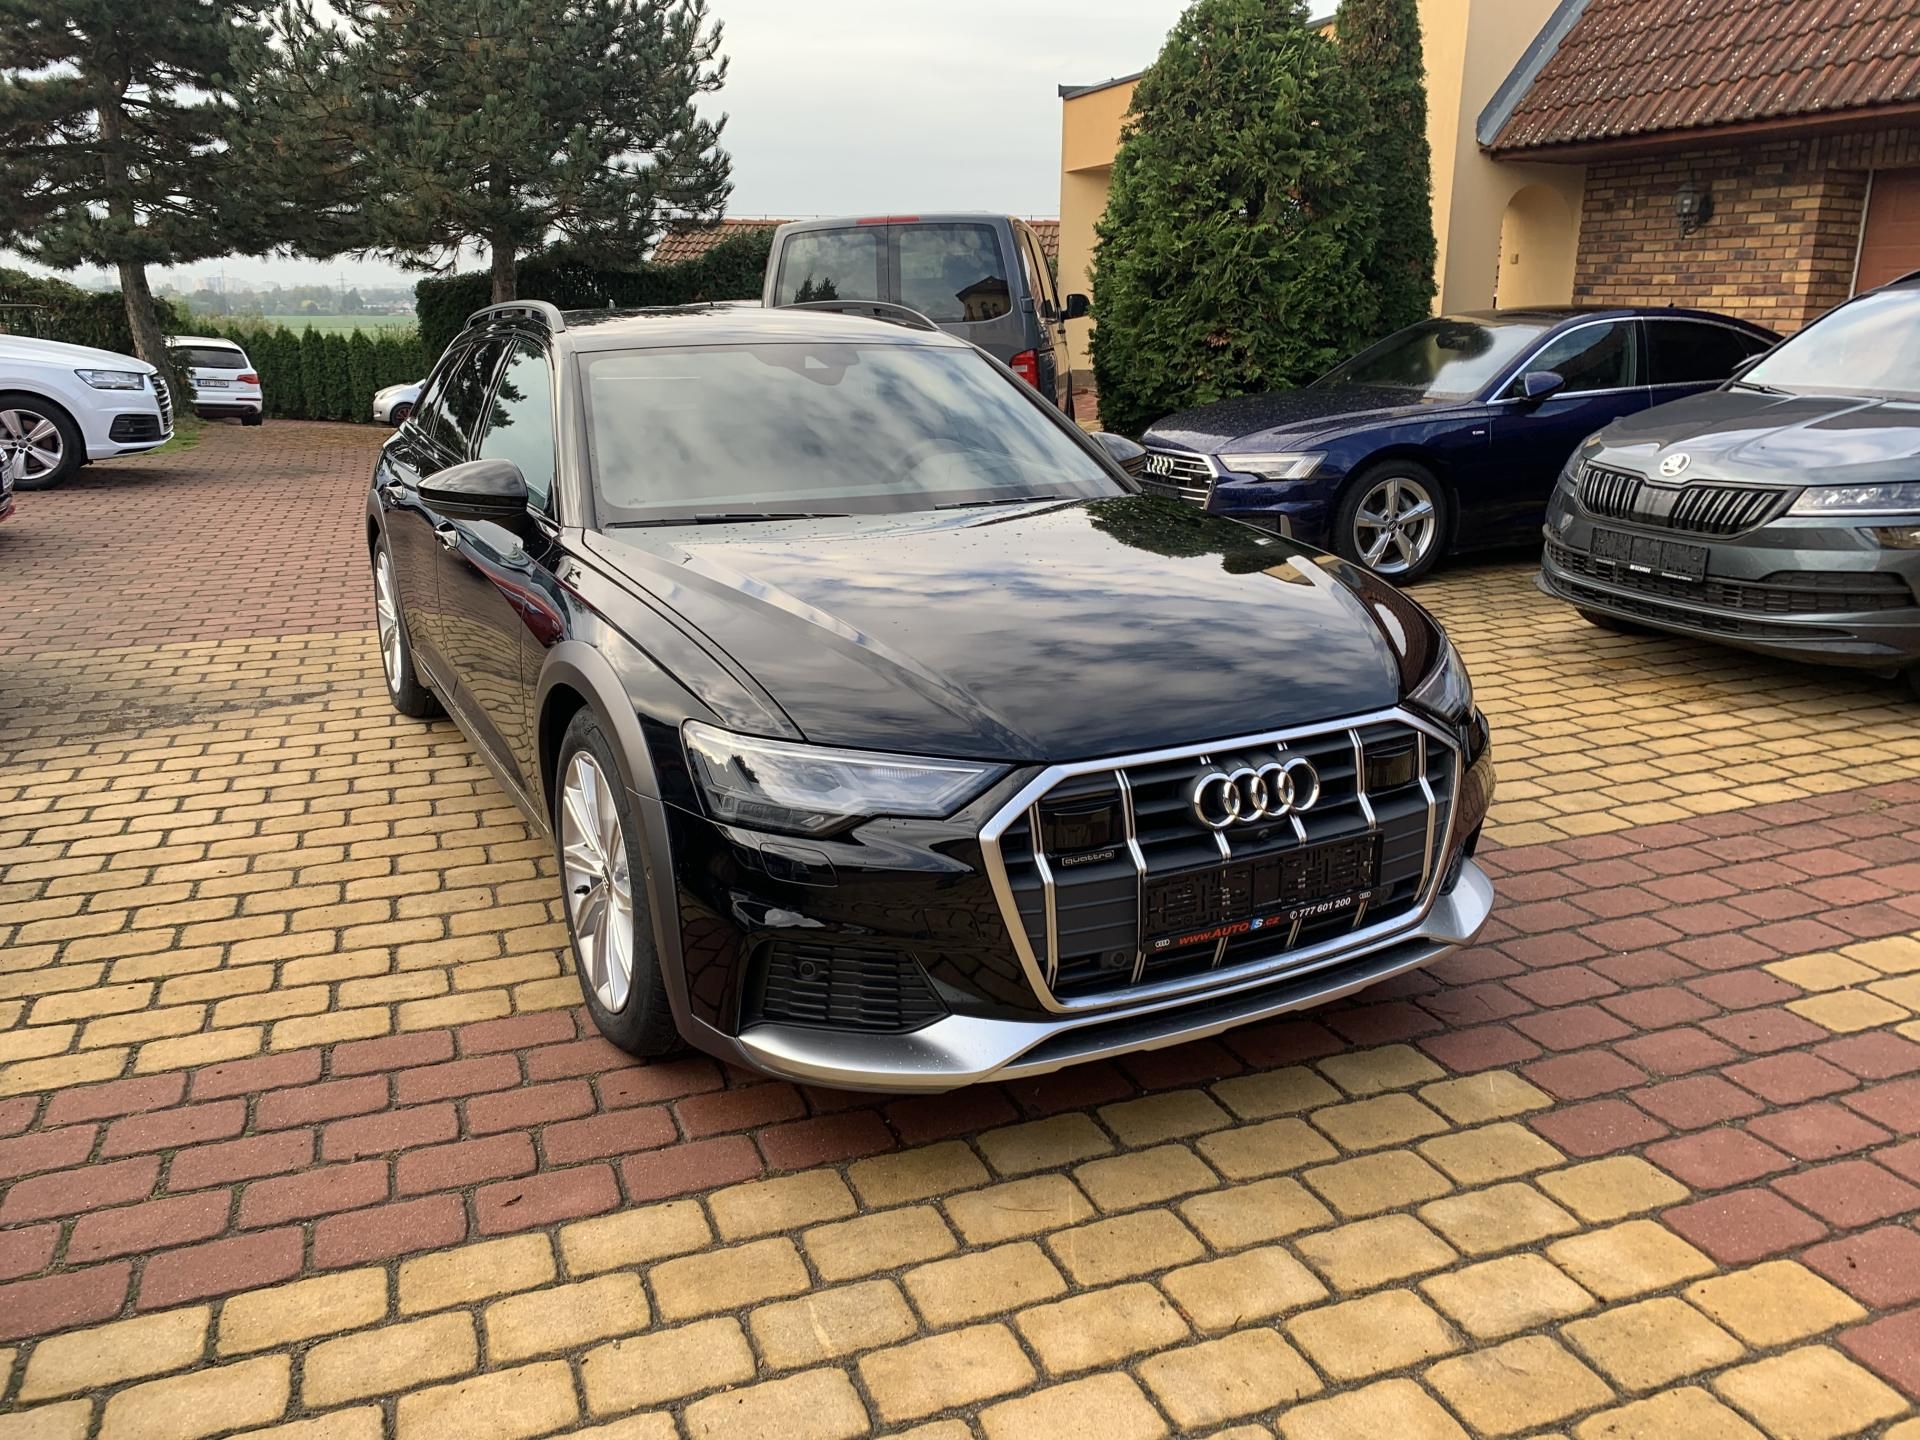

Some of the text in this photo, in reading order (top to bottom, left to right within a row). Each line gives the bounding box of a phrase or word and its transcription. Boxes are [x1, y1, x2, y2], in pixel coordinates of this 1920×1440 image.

[1064, 851, 1113, 865] quattro
[1299, 906, 1317, 918] 777
[1317, 902, 1333, 913] 601
[1335, 897, 1351, 909] 200
